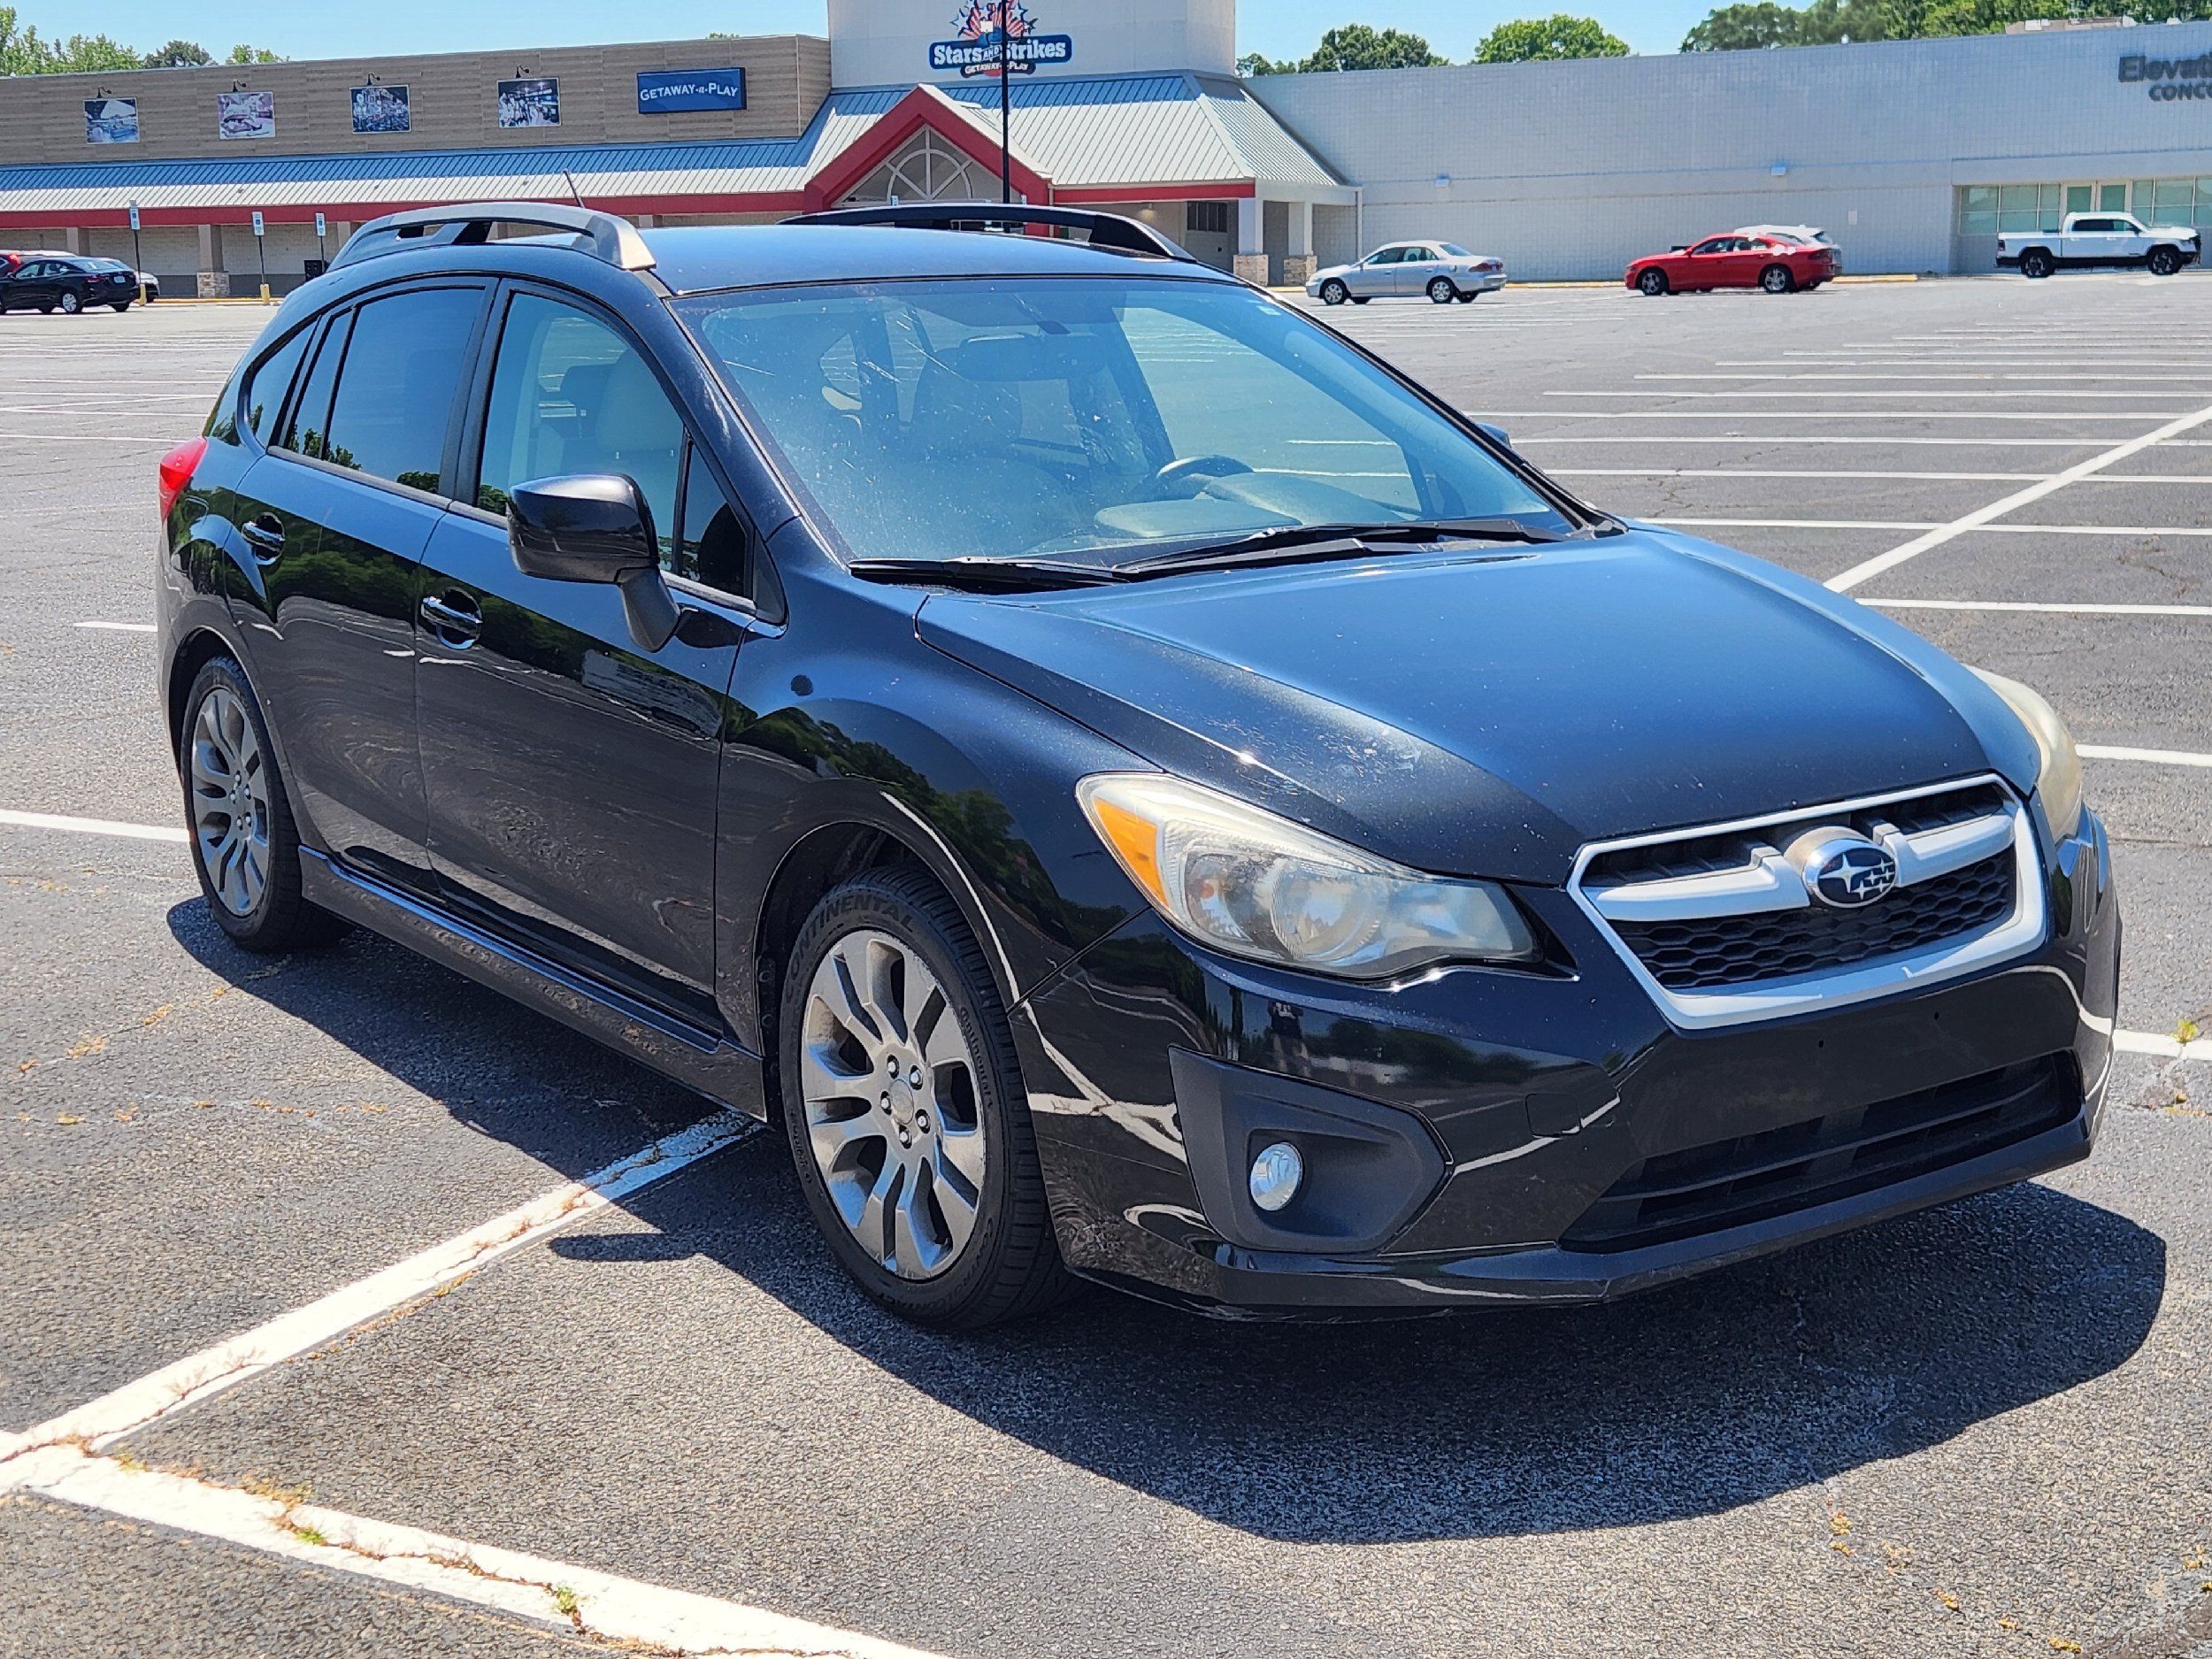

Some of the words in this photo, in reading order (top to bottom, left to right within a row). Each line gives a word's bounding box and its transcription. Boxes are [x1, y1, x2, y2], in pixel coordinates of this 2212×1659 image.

[933, 45, 982, 65] Stars
[983, 46, 1000, 61] AND
[2117, 51, 2212, 82] Elevat
[786, 895, 914, 1005] CONTINENTAL
